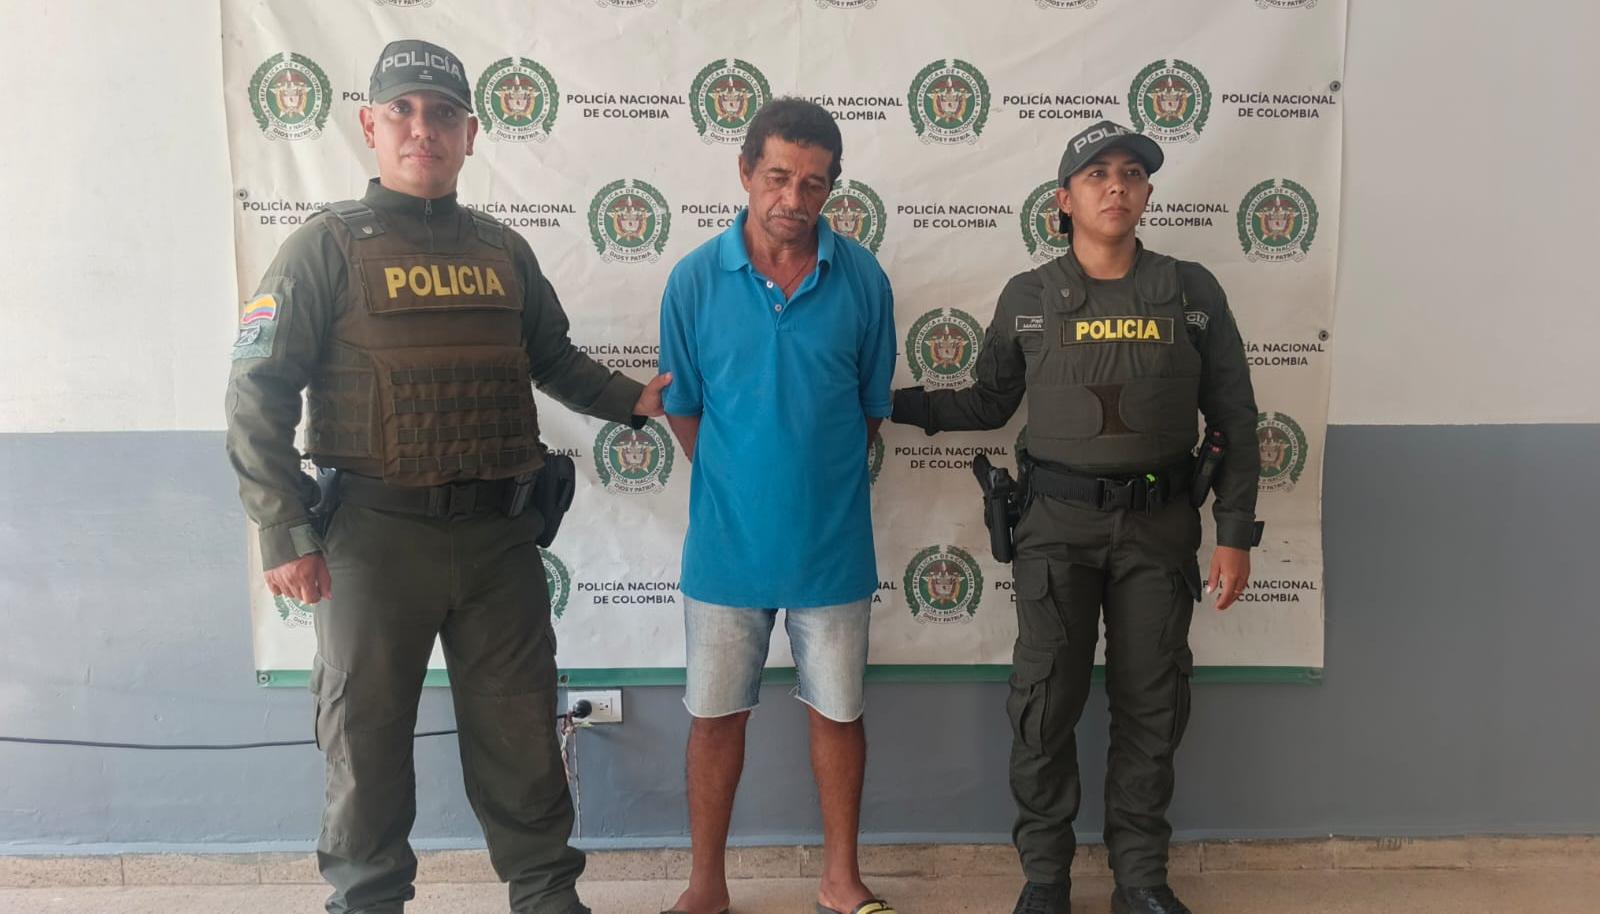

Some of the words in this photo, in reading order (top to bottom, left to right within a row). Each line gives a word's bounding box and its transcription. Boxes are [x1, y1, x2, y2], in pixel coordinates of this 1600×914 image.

[567, 93, 616, 104] POLICÍA
[620, 95, 685, 104] NACIONAL
[838, 97, 902, 106] NACIONAL
[1003, 93, 1052, 105] POLICÍA
[1056, 96, 1120, 105] NACIONAL
[1222, 92, 1270, 103] POLICÍA
[1273, 95, 1335, 104] NACIONAL
[584, 109, 599, 117] DE
[603, 109, 669, 118] COLOMBIA
[832, 111, 886, 120] OLOMBIA
[1019, 110, 1034, 118] DE
[1039, 110, 1103, 119] COLOMBIA
[1238, 108, 1253, 117] DE
[1257, 108, 1319, 118] COLOMBIA
[243, 200, 292, 210] POLICÍA
[511, 204, 576, 213] NACIONAL
[682, 203, 730, 214] POLICÍA
[898, 203, 945, 214] POLICÍA
[949, 205, 1013, 214] NACIONAL
[1167, 204, 1229, 213] NACIONAL
[260, 216, 276, 224] DE
[698, 219, 713, 227] DE
[914, 219, 928, 228] DE
[932, 219, 997, 228] COLOMBIA
[1150, 218, 1213, 226] COLOMBIA
[384, 265, 506, 298] POLICIA
[1076, 319, 1160, 340] POLICIA
[624, 346, 660, 354] NACIO
[1263, 344, 1324, 352] NACIONAL
[607, 359, 658, 368] COLOMB
[895, 445, 940, 456] POLICÍA
[946, 447, 1008, 456] NACIONAL
[911, 460, 925, 468] DE
[929, 460, 973, 469] COLOM
[578, 581, 624, 591] POLICÍA
[1253, 580, 1317, 590] NACIONAL
[594, 596, 608, 604] DE
[612, 595, 675, 604] COLOMBIA
